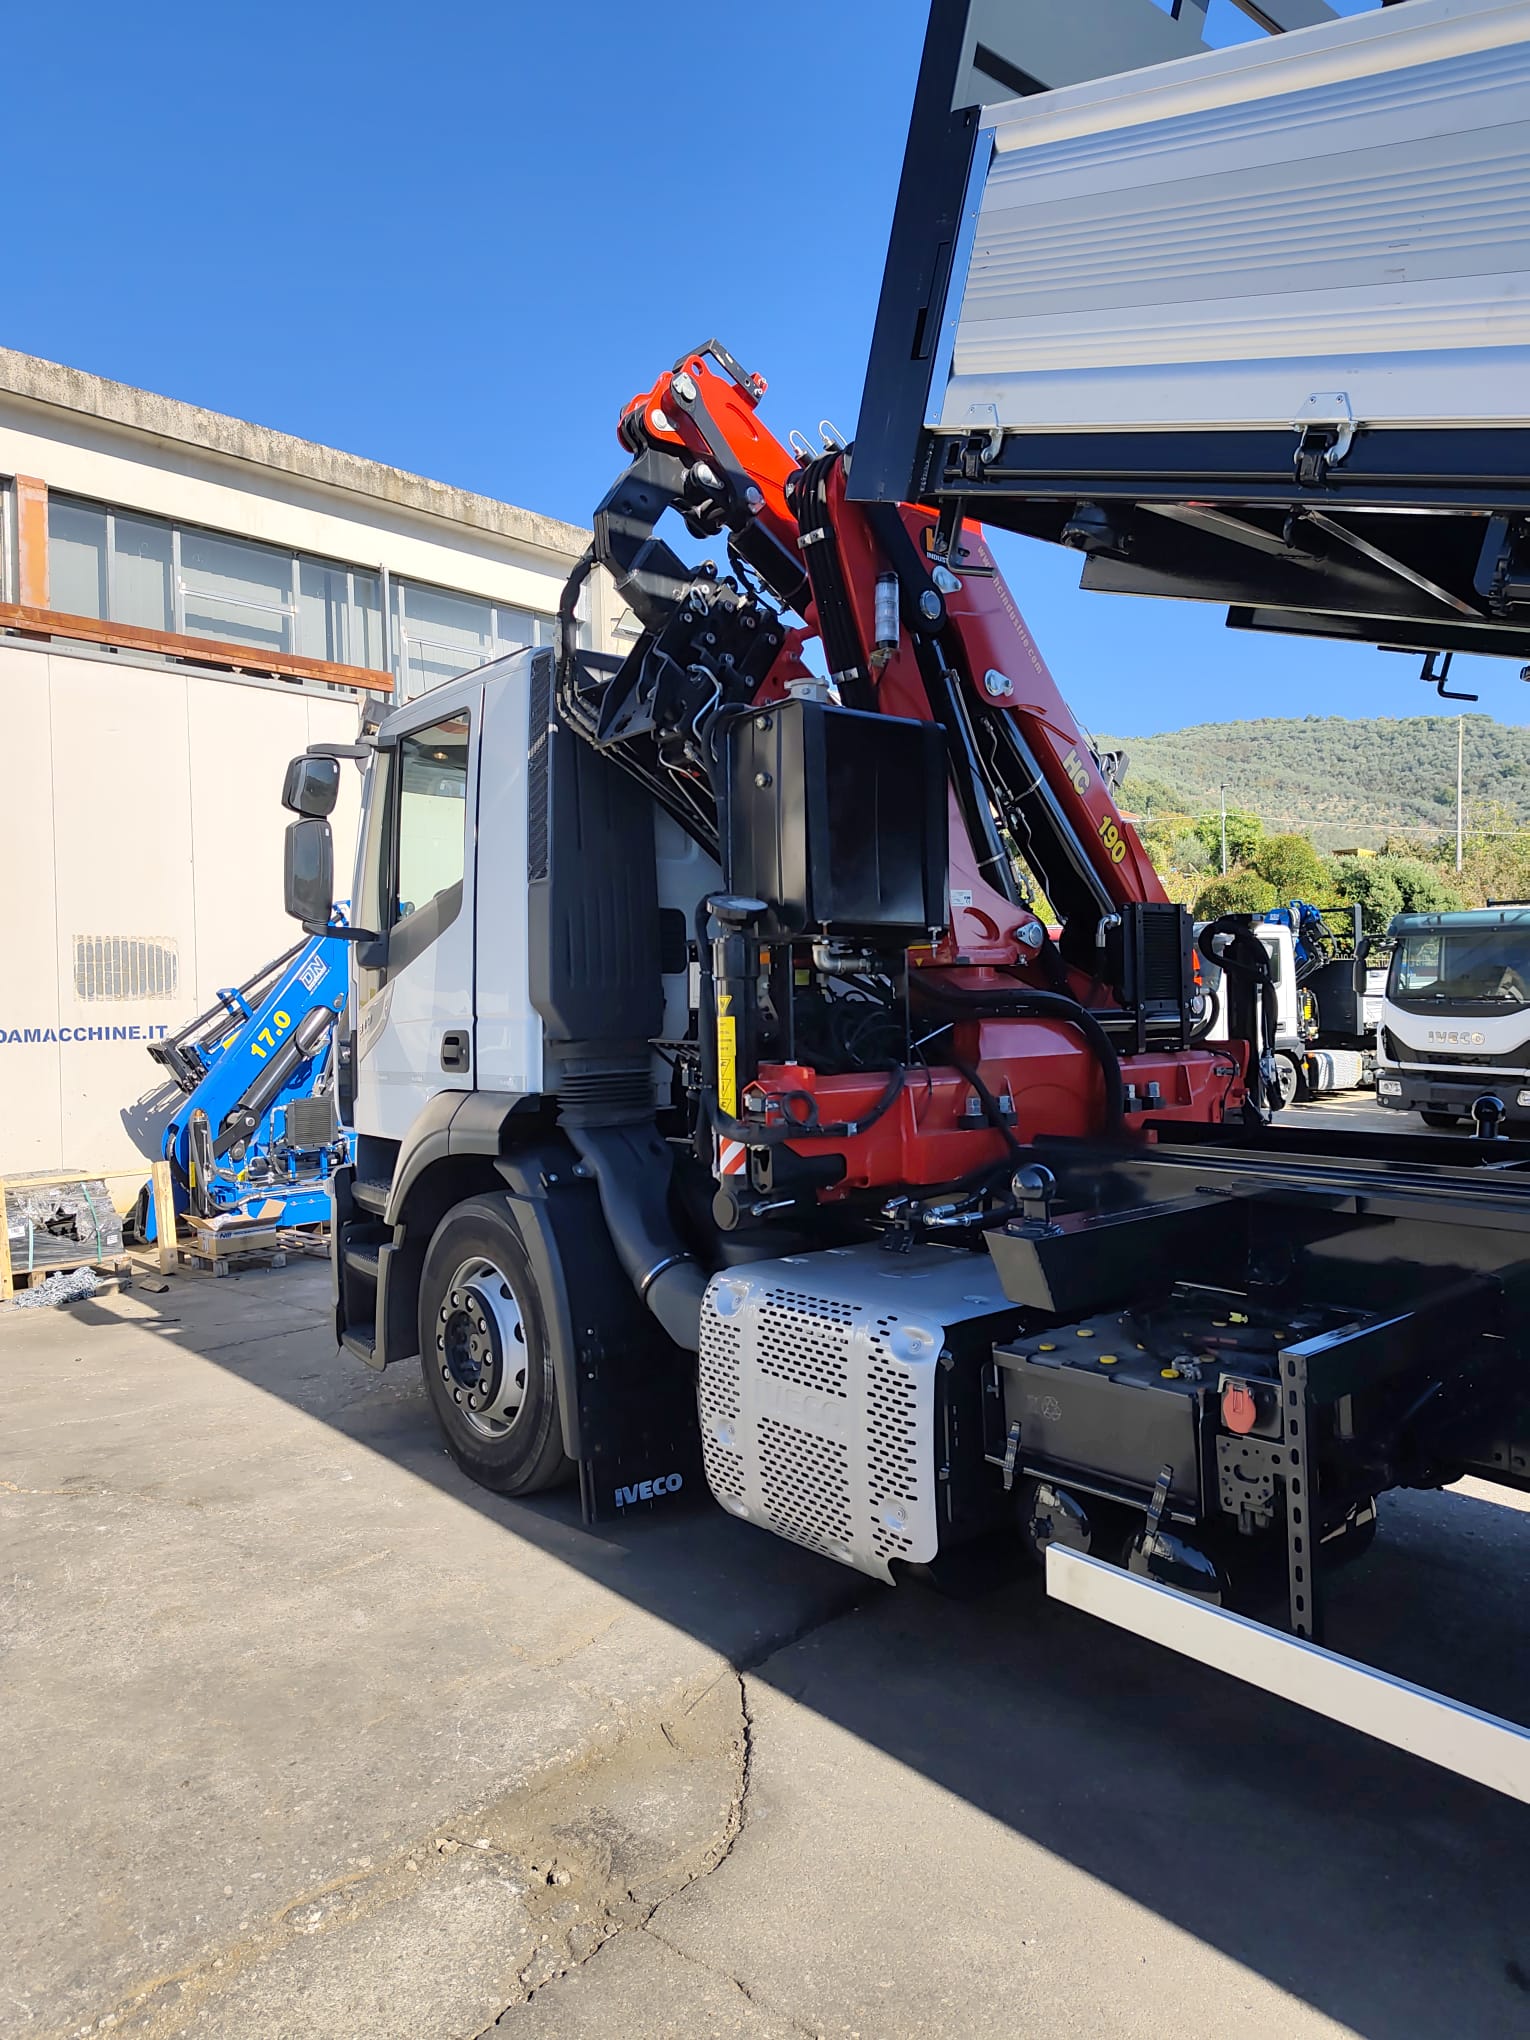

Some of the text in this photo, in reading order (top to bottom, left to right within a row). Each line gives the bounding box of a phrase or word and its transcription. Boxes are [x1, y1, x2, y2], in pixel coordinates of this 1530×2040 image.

[1062, 749, 1126, 864] HC 190
[251, 1010, 291, 1058] 17.0
[1426, 1031, 1486, 1046] IVECO
[614, 1472, 683, 1508] IVECO
